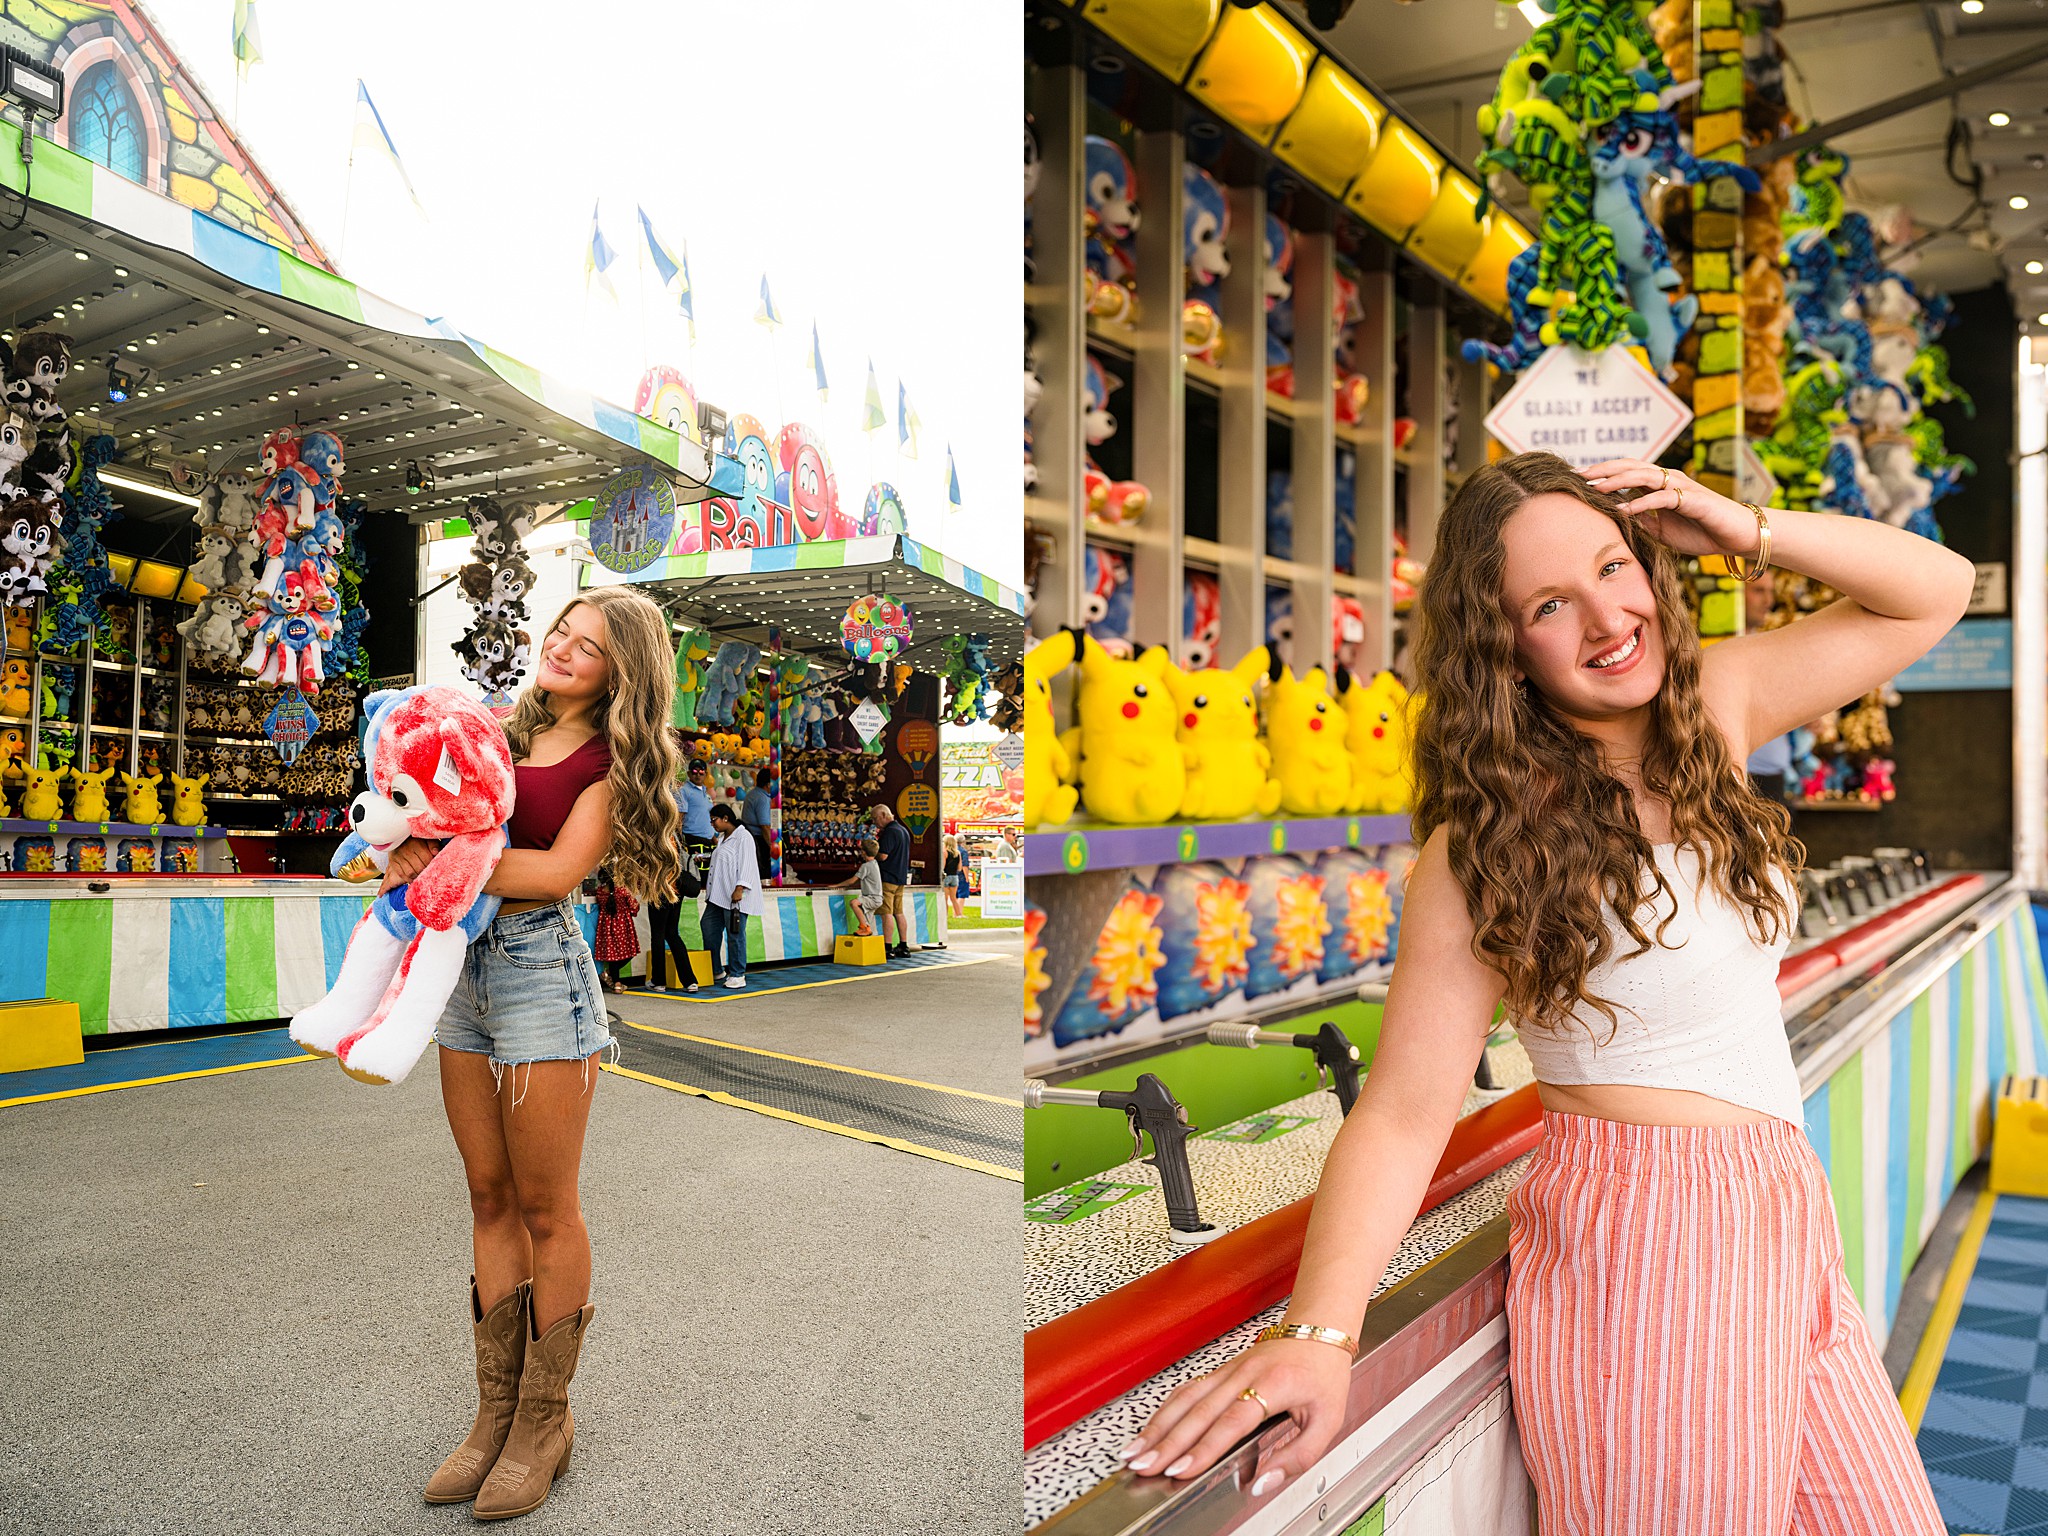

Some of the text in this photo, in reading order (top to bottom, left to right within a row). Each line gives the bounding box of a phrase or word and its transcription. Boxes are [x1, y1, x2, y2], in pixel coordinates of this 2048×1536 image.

[1576, 369, 1598, 385] WE
[1524, 397, 1650, 417] GLADLY ACCEPT
[1531, 426, 1648, 445] CREDIT CARDS
[591, 470, 675, 521] WATER FUN
[596, 538, 662, 572] CASTLE
[844, 623, 911, 640] Balloons
[278, 719, 304, 730] WINS
[272, 731, 309, 742] CHOICE
[942, 766, 1003, 787] ZZA
[50, 824, 57, 832] 15
[1182, 833, 1195, 859] 7
[1273, 830, 1285, 850] 8
[1068, 841, 1083, 867] 6
